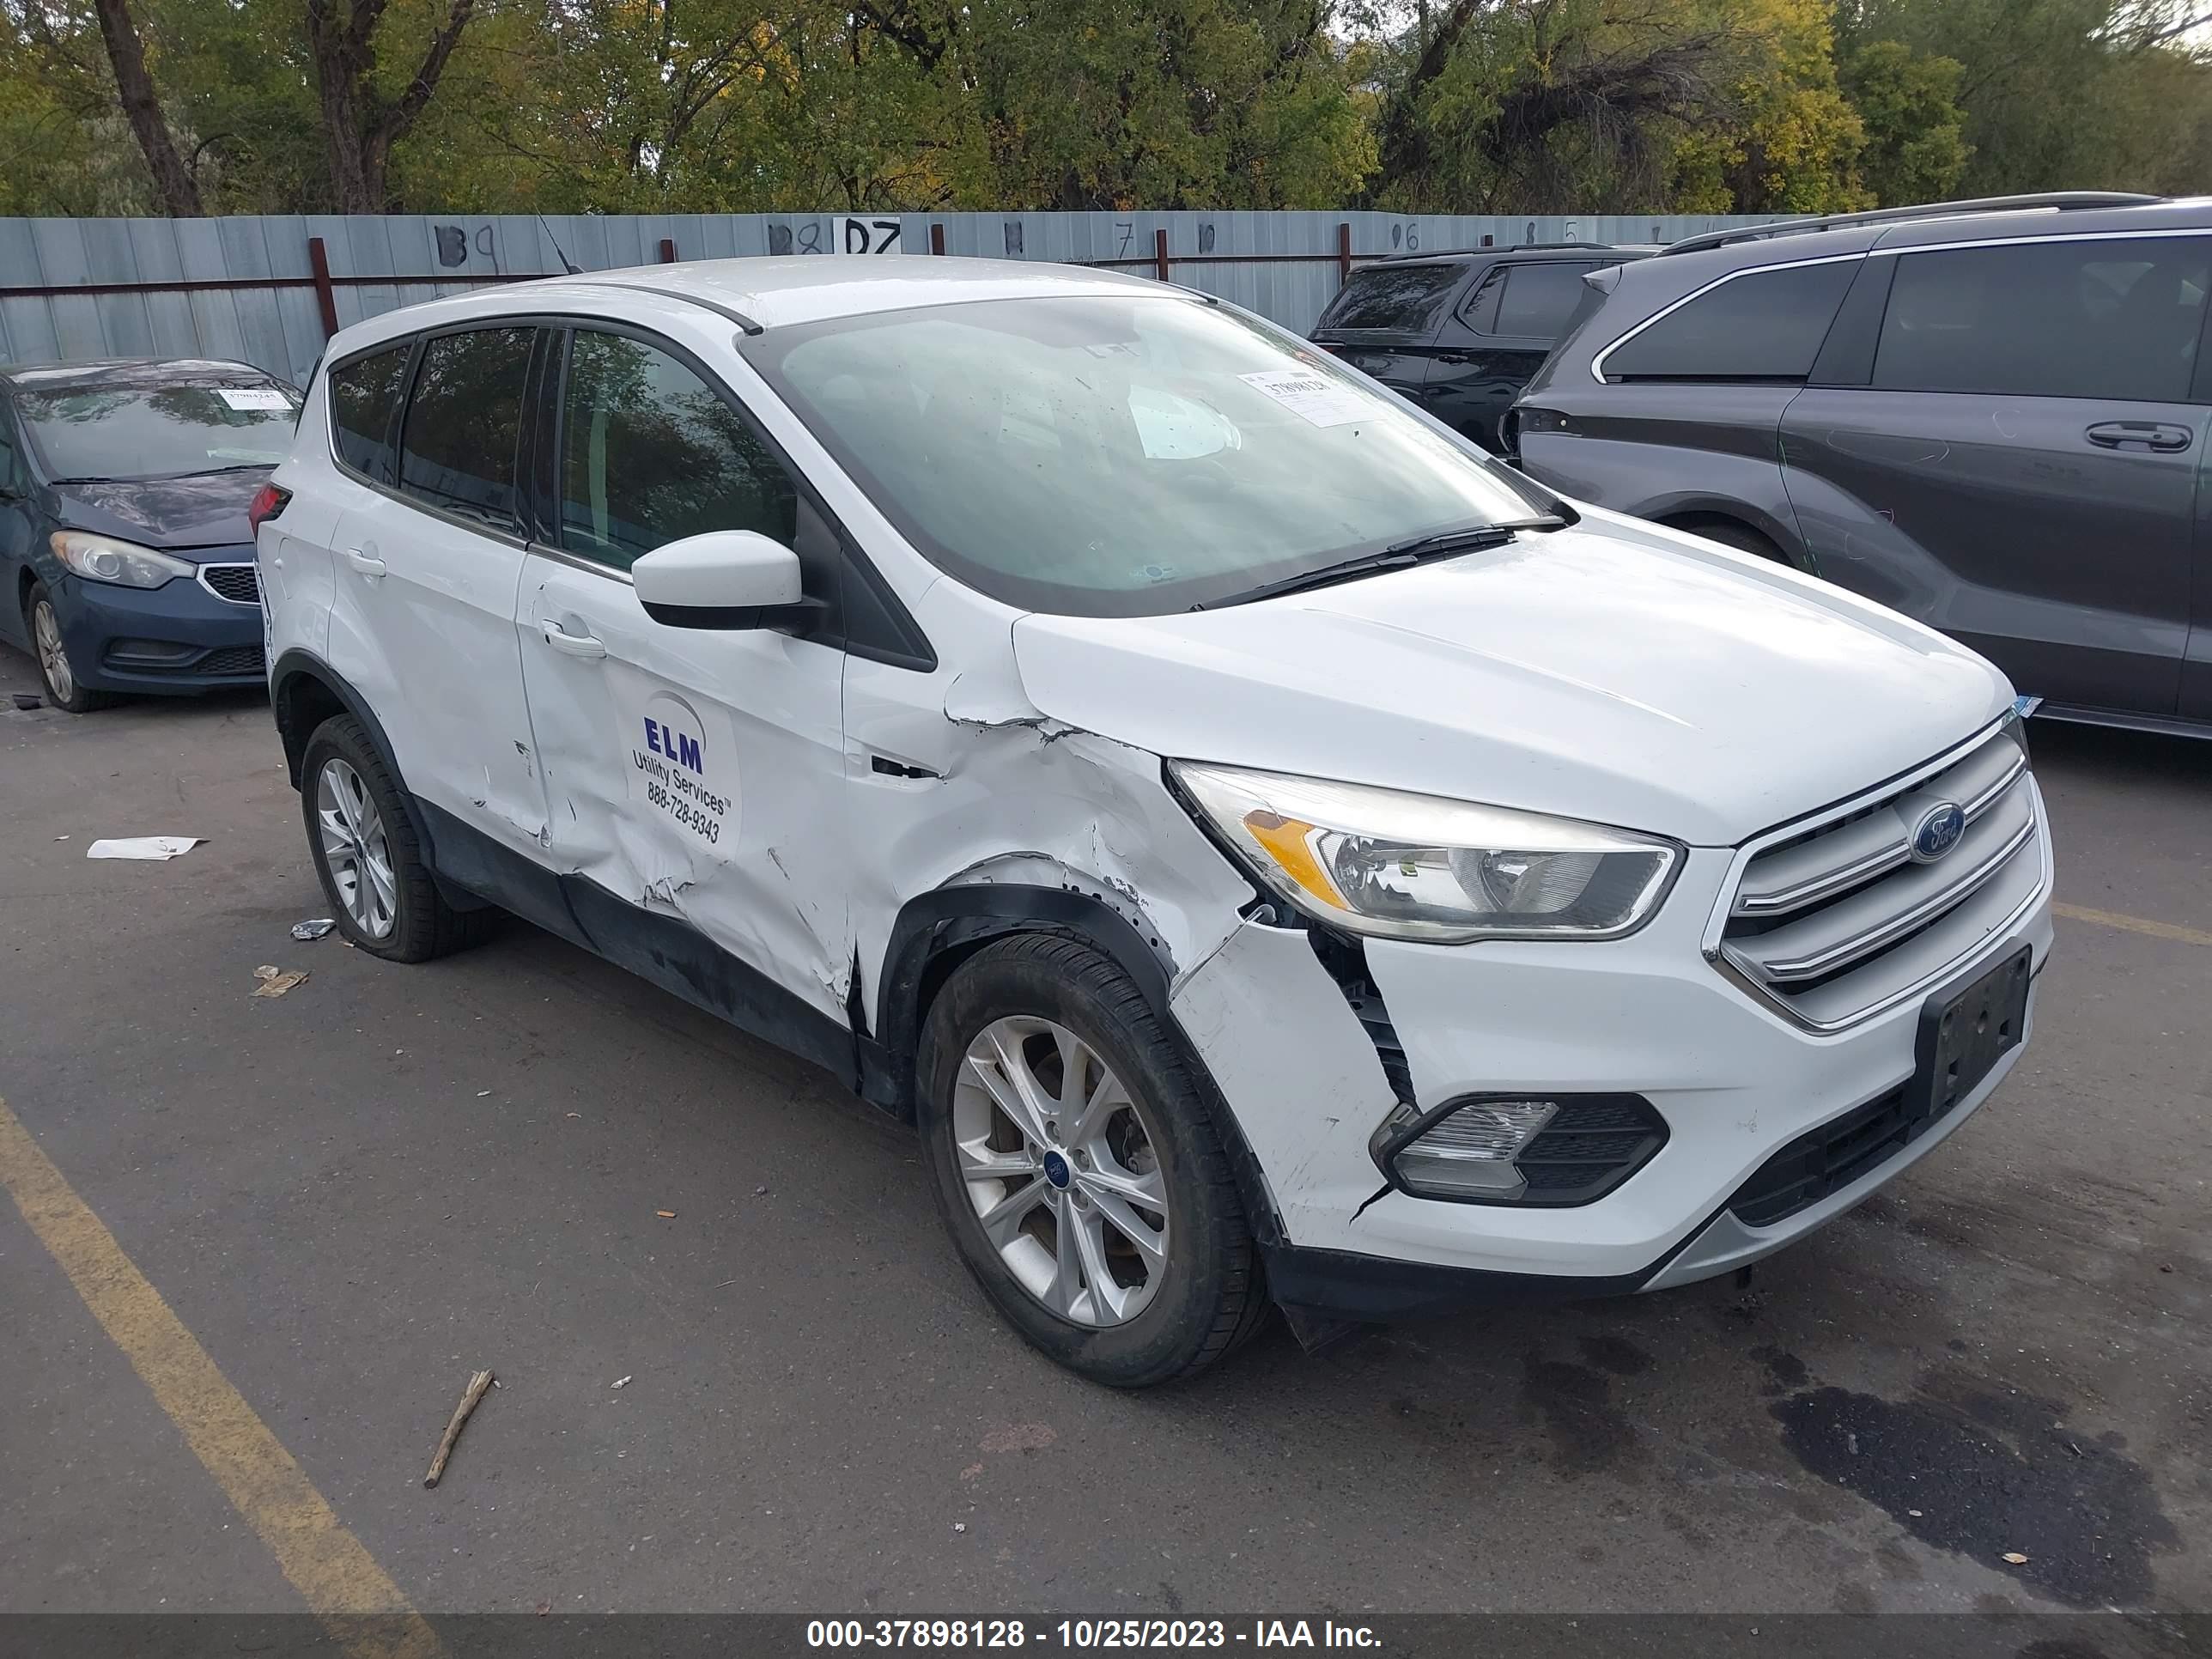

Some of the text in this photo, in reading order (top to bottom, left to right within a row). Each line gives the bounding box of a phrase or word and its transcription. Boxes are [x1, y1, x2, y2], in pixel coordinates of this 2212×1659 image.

[632, 749, 670, 787] Utility
[644, 717, 702, 775] ELM
[647, 782, 720, 843] 888-728-9343
